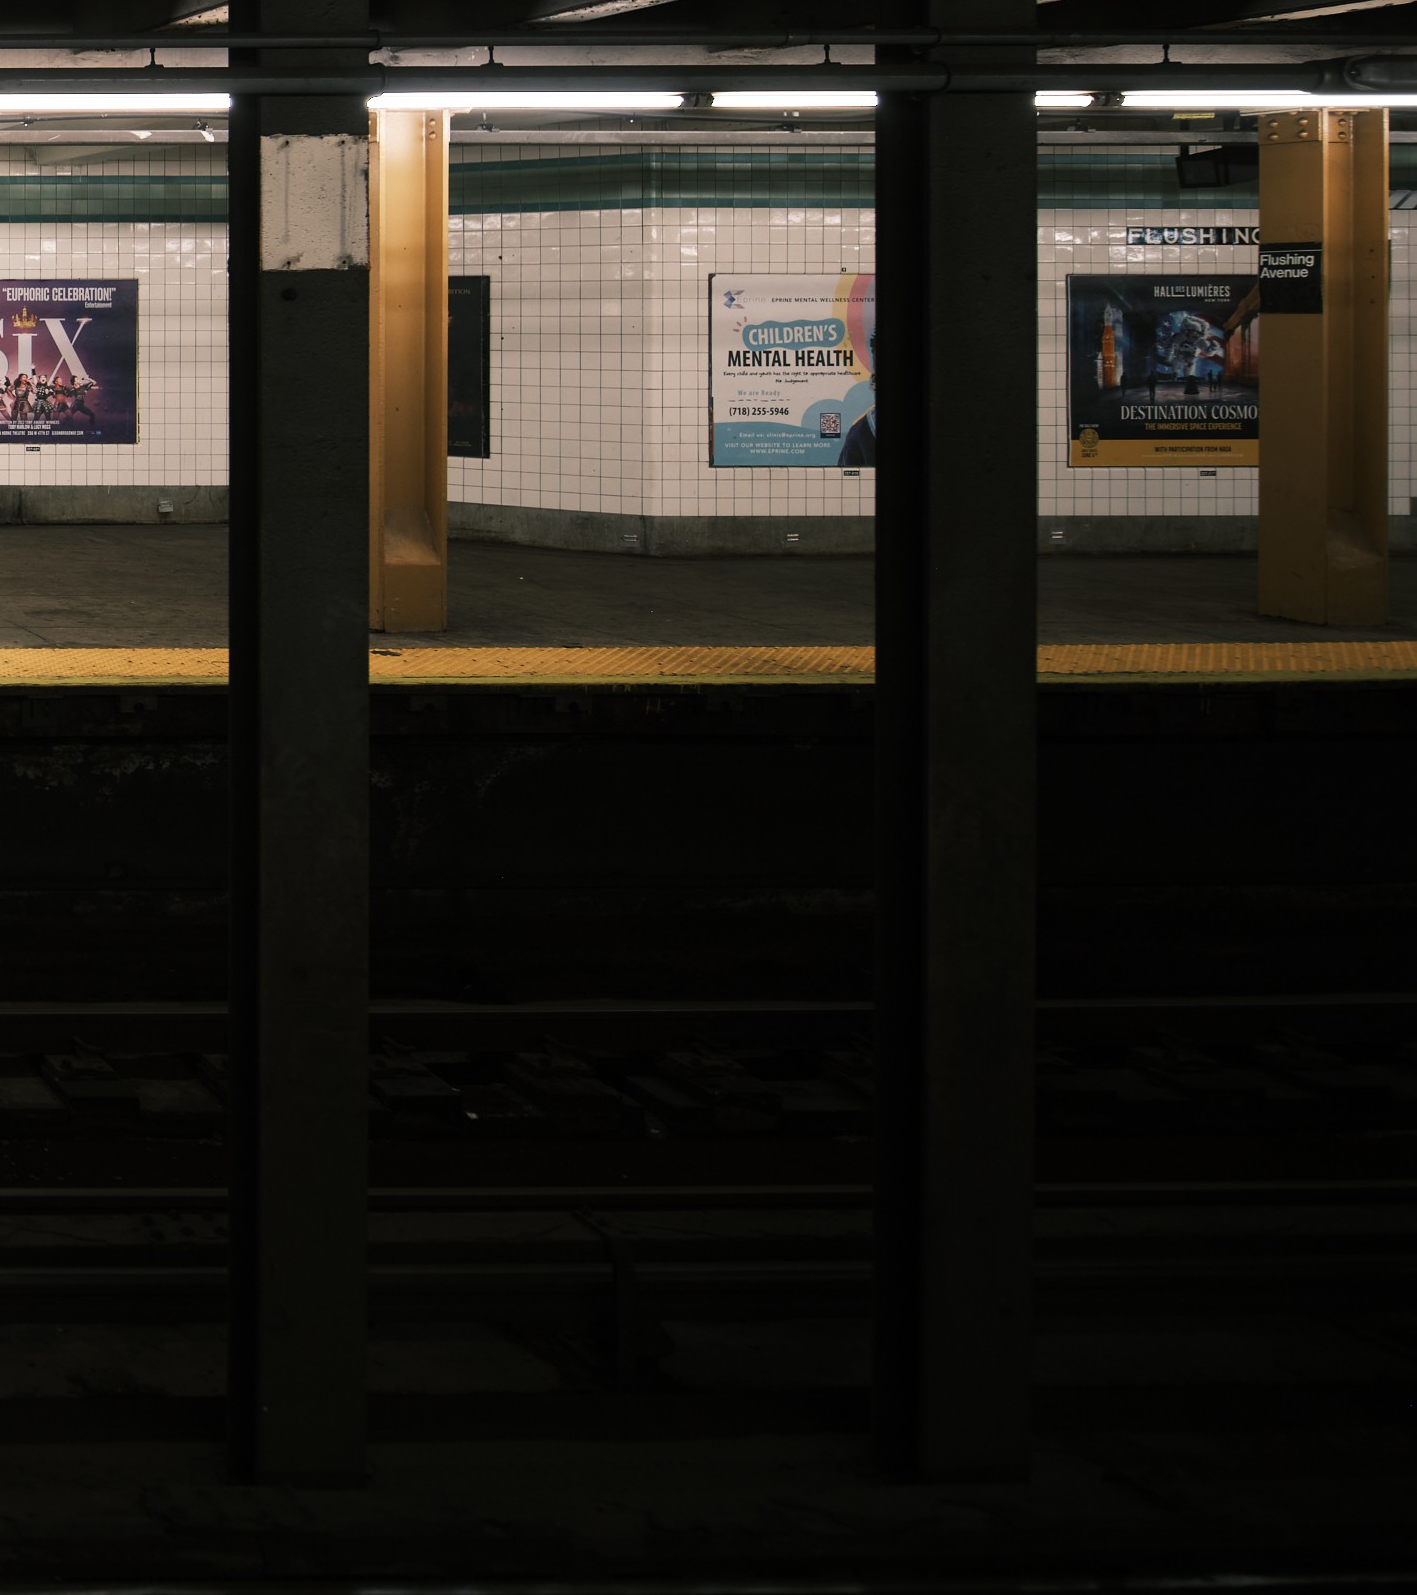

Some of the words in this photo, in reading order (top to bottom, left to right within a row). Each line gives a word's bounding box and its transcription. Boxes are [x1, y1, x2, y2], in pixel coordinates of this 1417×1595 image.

[1260, 253, 1315, 268] Flushing
[1260, 267, 1309, 279] Avenue
[2, 287, 49, 302] "EUPHORIC
[52, 287, 116, 302] CELEBRATION!"
[1154, 286, 1174, 297] HALL
[1186, 284, 1230, 297] LUMIÈRES
[748, 324, 838, 346] CHILDREN'S
[728, 350, 791, 367] MENTAL
[795, 350, 854, 367] HEALTH
[729, 407, 750, 416] (718)
[751, 407, 789, 416] 255-5946
[1120, 405, 1206, 420] DESTINATION
[1211, 405, 1259, 420] COSMO
[1144, 422, 1157, 430] THE
[1157, 422, 1188, 430] IMMERSIVE
[1190, 422, 1207, 430] SPACE
[1208, 422, 1242, 430] EXPERIENCE
